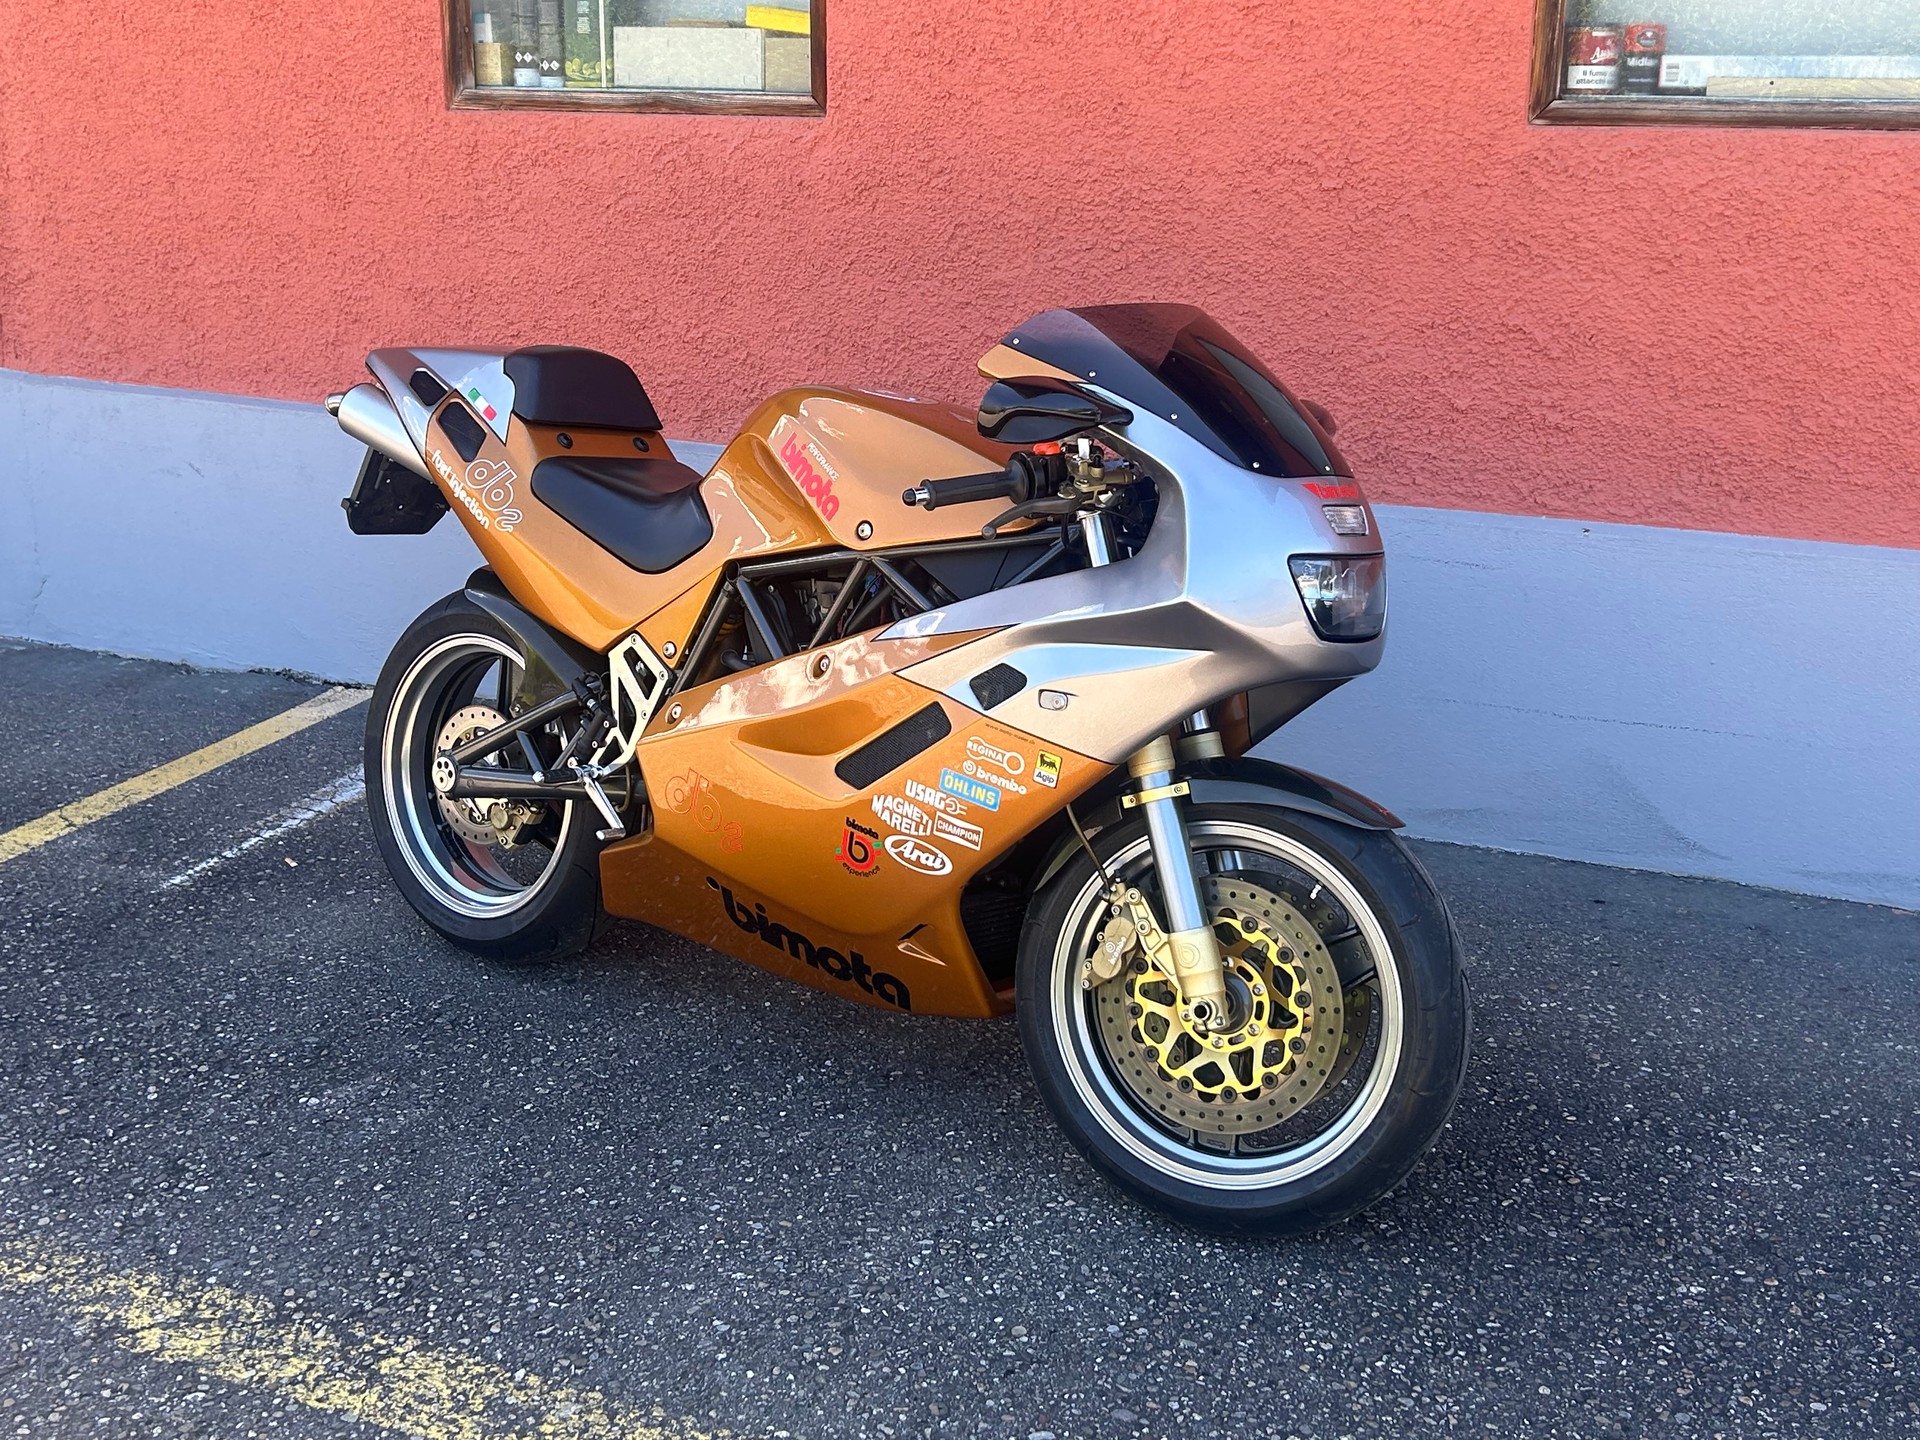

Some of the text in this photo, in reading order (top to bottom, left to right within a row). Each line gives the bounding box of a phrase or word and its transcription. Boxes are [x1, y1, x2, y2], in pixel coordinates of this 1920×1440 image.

[780, 432, 840, 522] bimota
[447, 475, 490, 529] injection
[966, 740, 1004, 763] REGINA
[944, 771, 996, 806] ÖHLINS
[976, 764, 1027, 795] brembo
[1036, 771, 1055, 784] Agip
[872, 794, 932, 828] MAGNETI
[872, 803, 932, 837] MARELLI
[845, 816, 879, 840] bimota
[938, 820, 980, 842] CHAMPION
[842, 862, 881, 878] experience
[889, 841, 944, 871] Arai
[720, 884, 912, 1012] bimota
